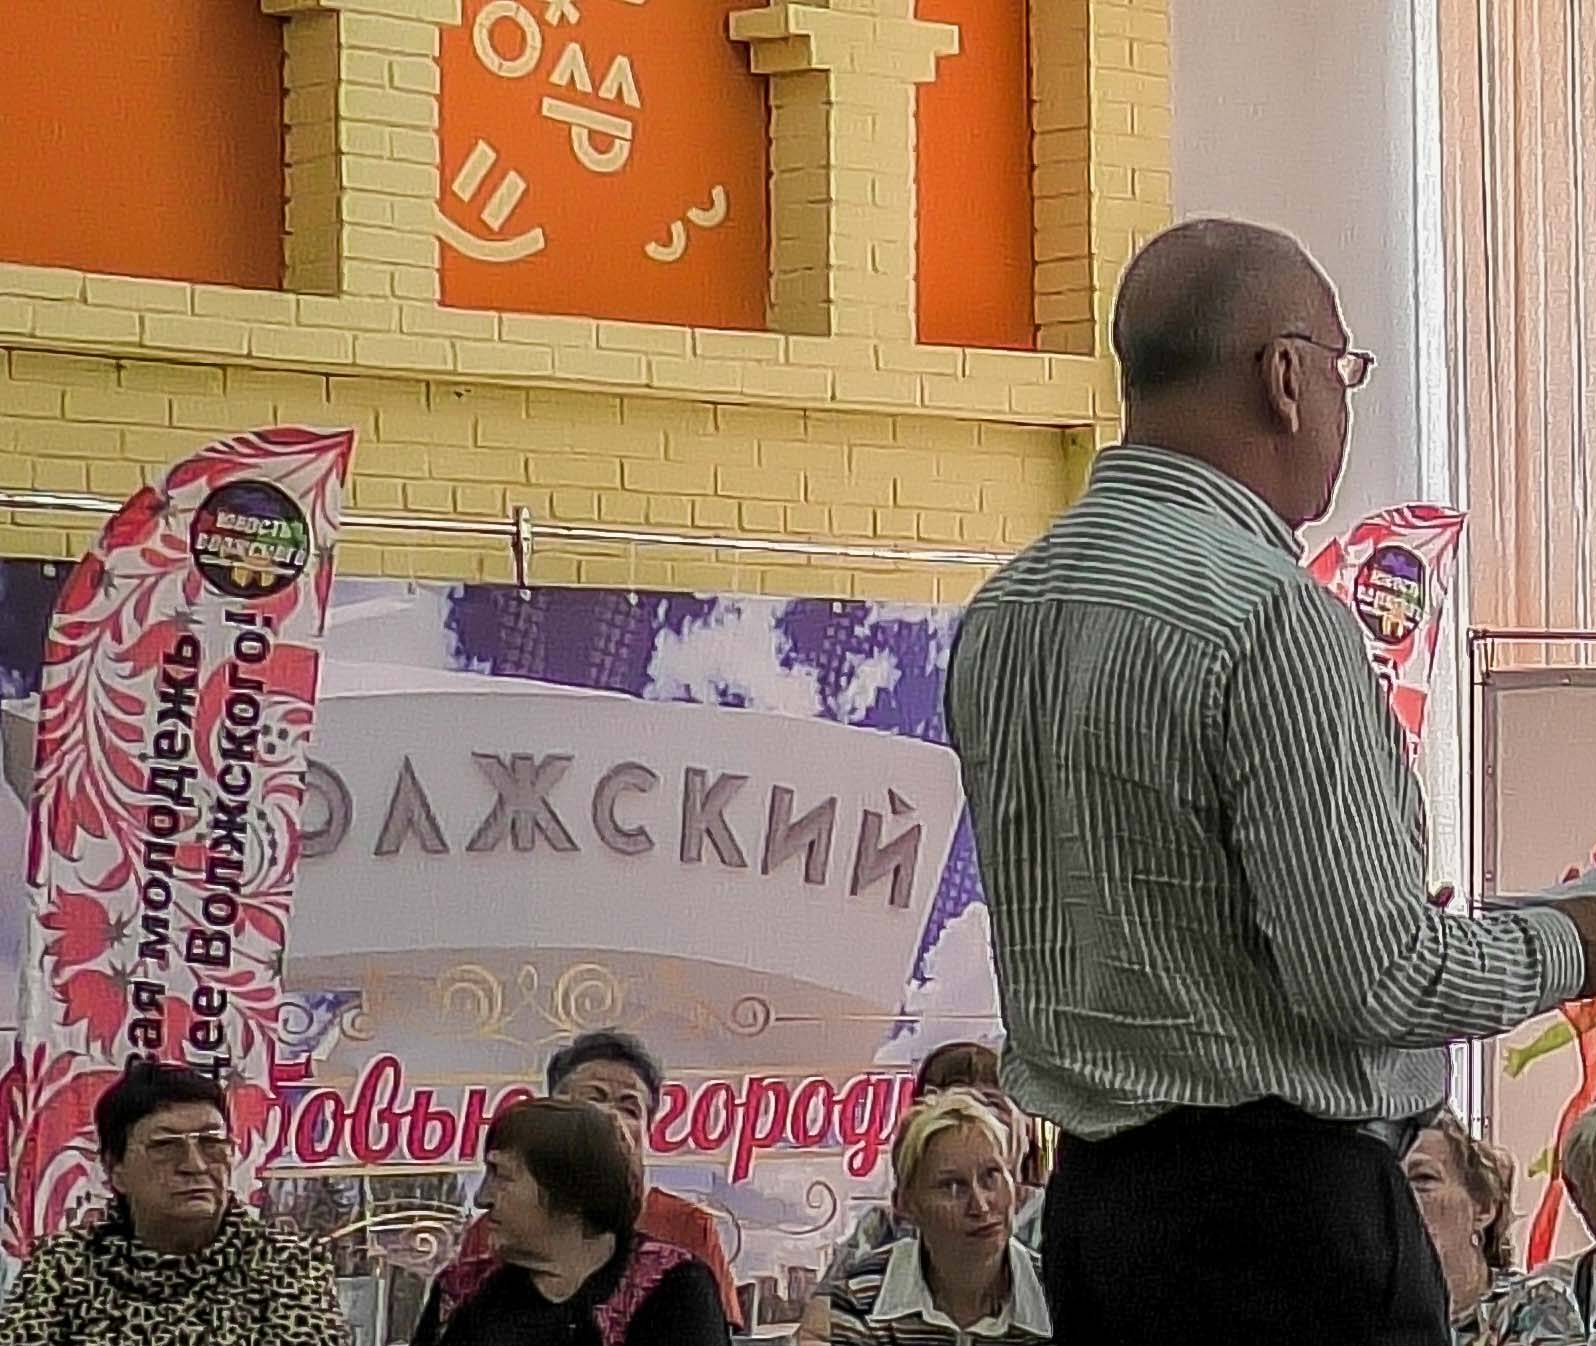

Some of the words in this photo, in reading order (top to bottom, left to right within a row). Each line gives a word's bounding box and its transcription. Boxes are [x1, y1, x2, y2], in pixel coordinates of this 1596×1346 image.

[139, 634, 201, 960] молодежь
[185, 608, 272, 967] Волжского!
[299, 751, 923, 909] ОЛЖСКИЙ
